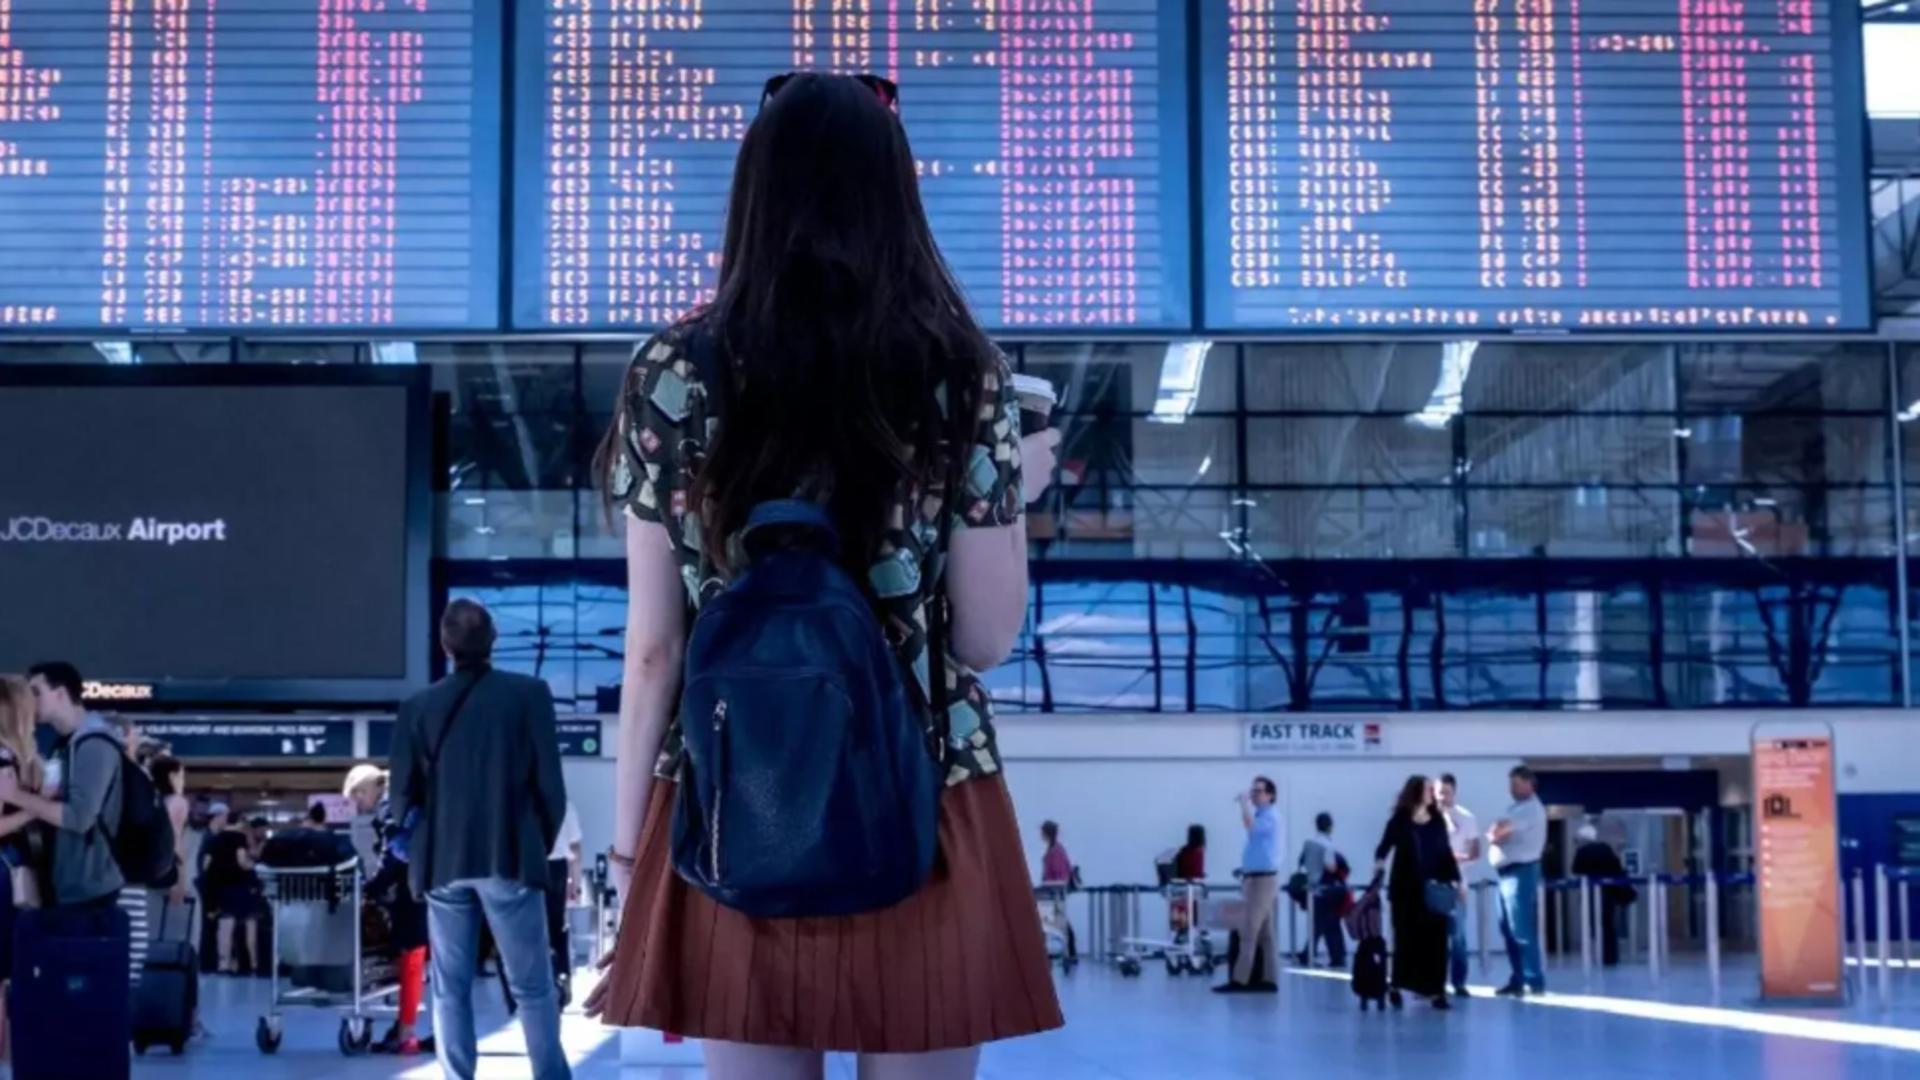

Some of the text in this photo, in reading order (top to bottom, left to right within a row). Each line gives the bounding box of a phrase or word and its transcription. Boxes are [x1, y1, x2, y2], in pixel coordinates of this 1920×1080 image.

[0, 517, 226, 544] JCDecaux Airport
[1250, 723, 1355, 739] FAST TRACK
